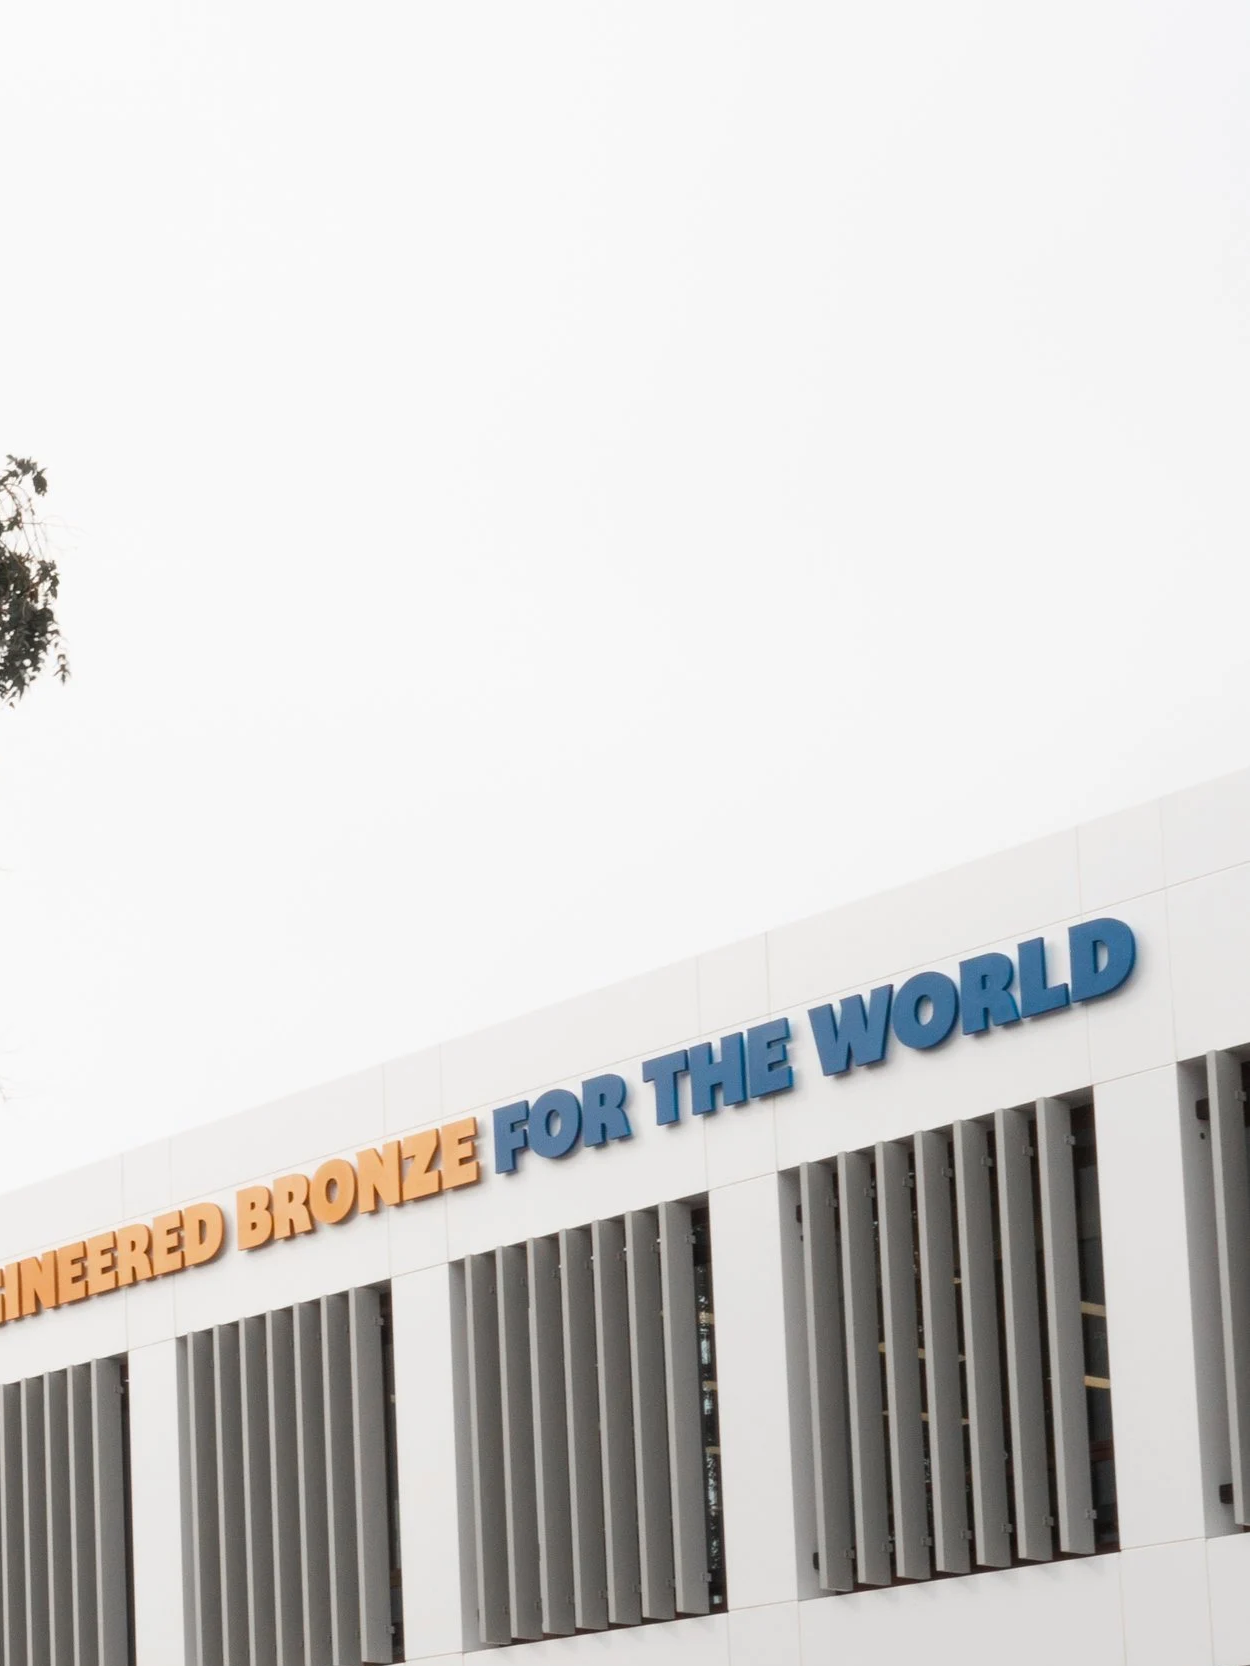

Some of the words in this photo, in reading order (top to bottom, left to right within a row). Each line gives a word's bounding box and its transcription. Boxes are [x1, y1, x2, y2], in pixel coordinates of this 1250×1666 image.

[236, 1117, 481, 1252] BRONZE
[492, 1073, 633, 1174] FOR
[642, 1017, 794, 1127] THE
[807, 917, 1137, 1077] WORLD
